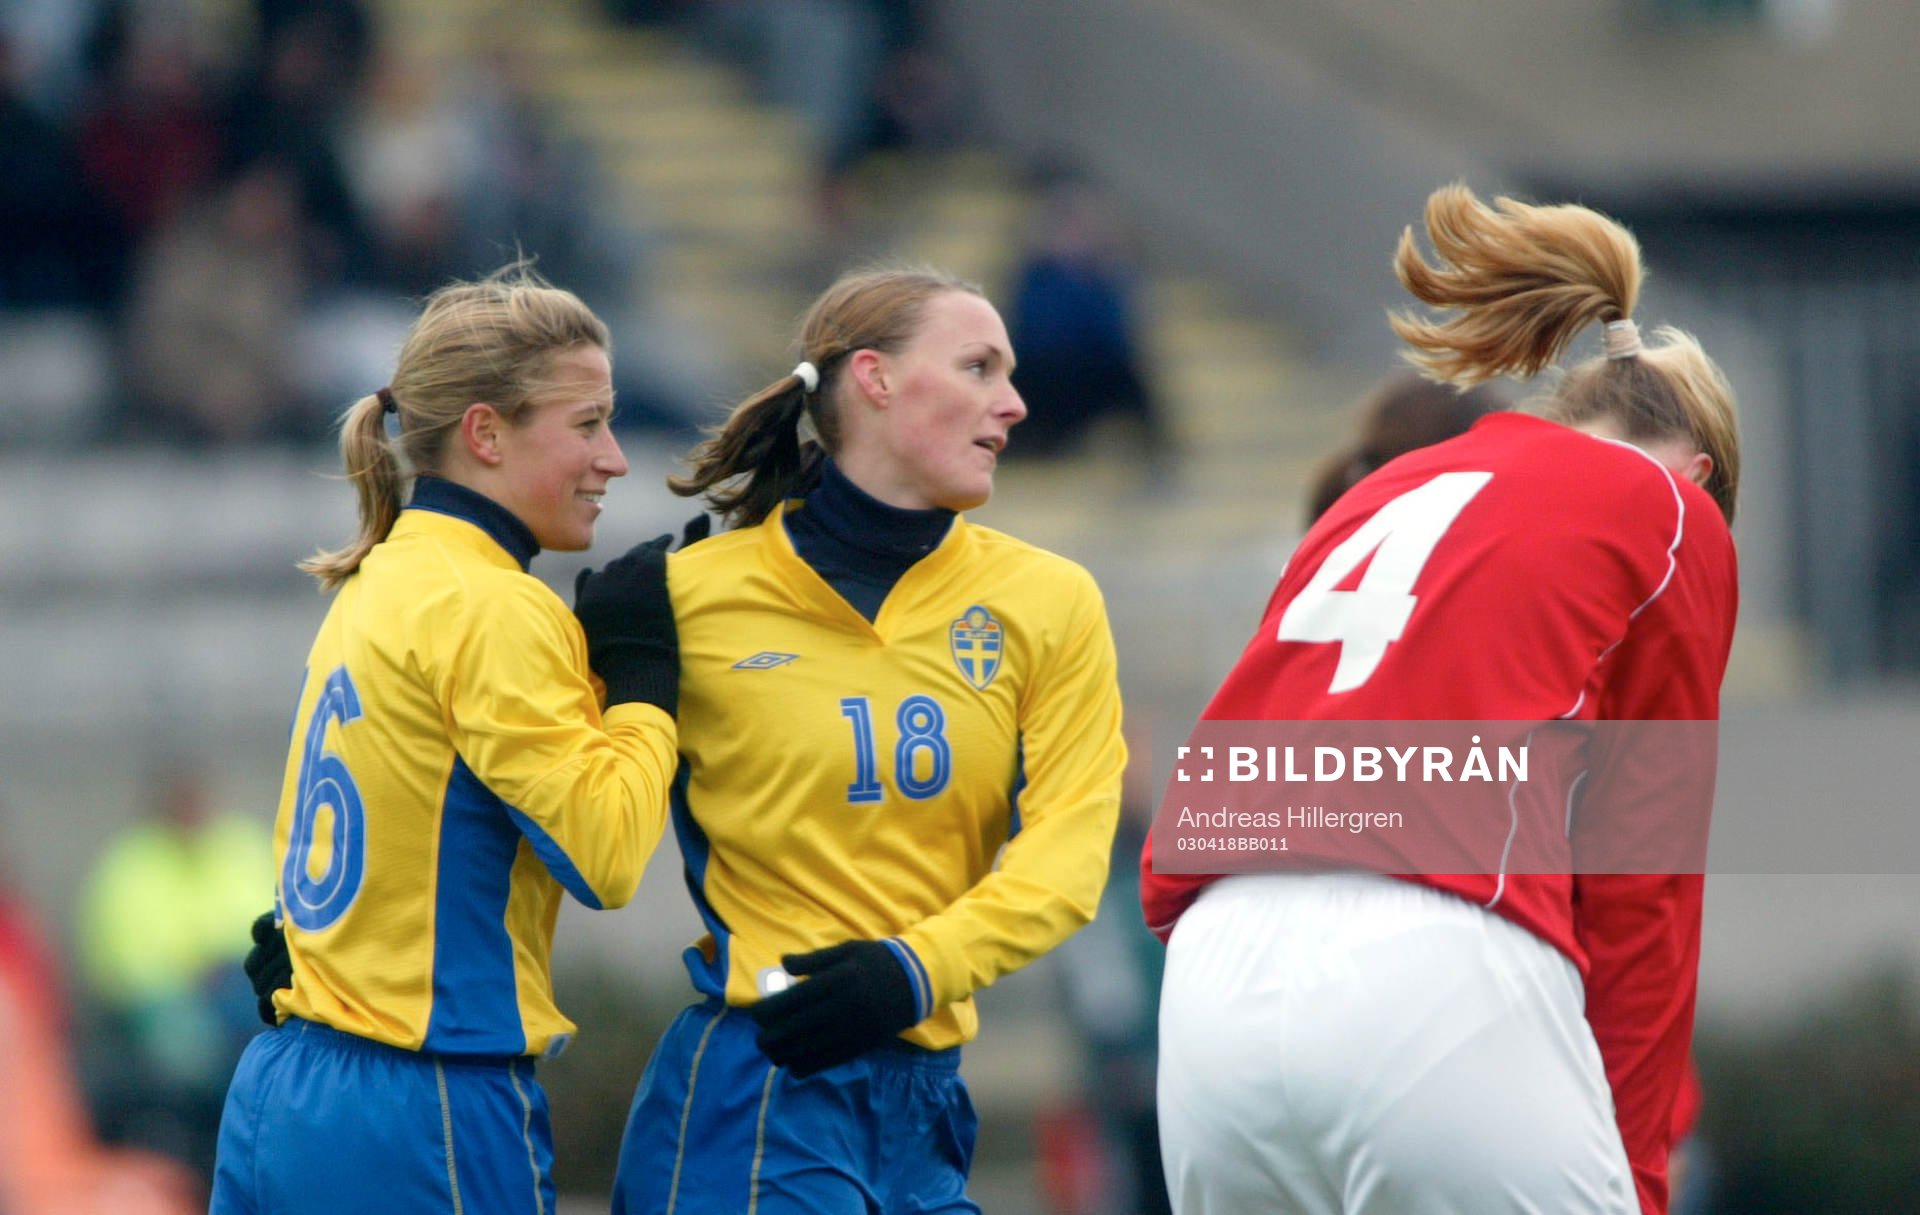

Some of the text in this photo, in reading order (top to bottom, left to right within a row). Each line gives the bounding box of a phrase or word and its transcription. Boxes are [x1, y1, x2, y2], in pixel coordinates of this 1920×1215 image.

[1277, 471, 1494, 694] 4
[274, 663, 367, 934] 6
[839, 694, 951, 804] 18
